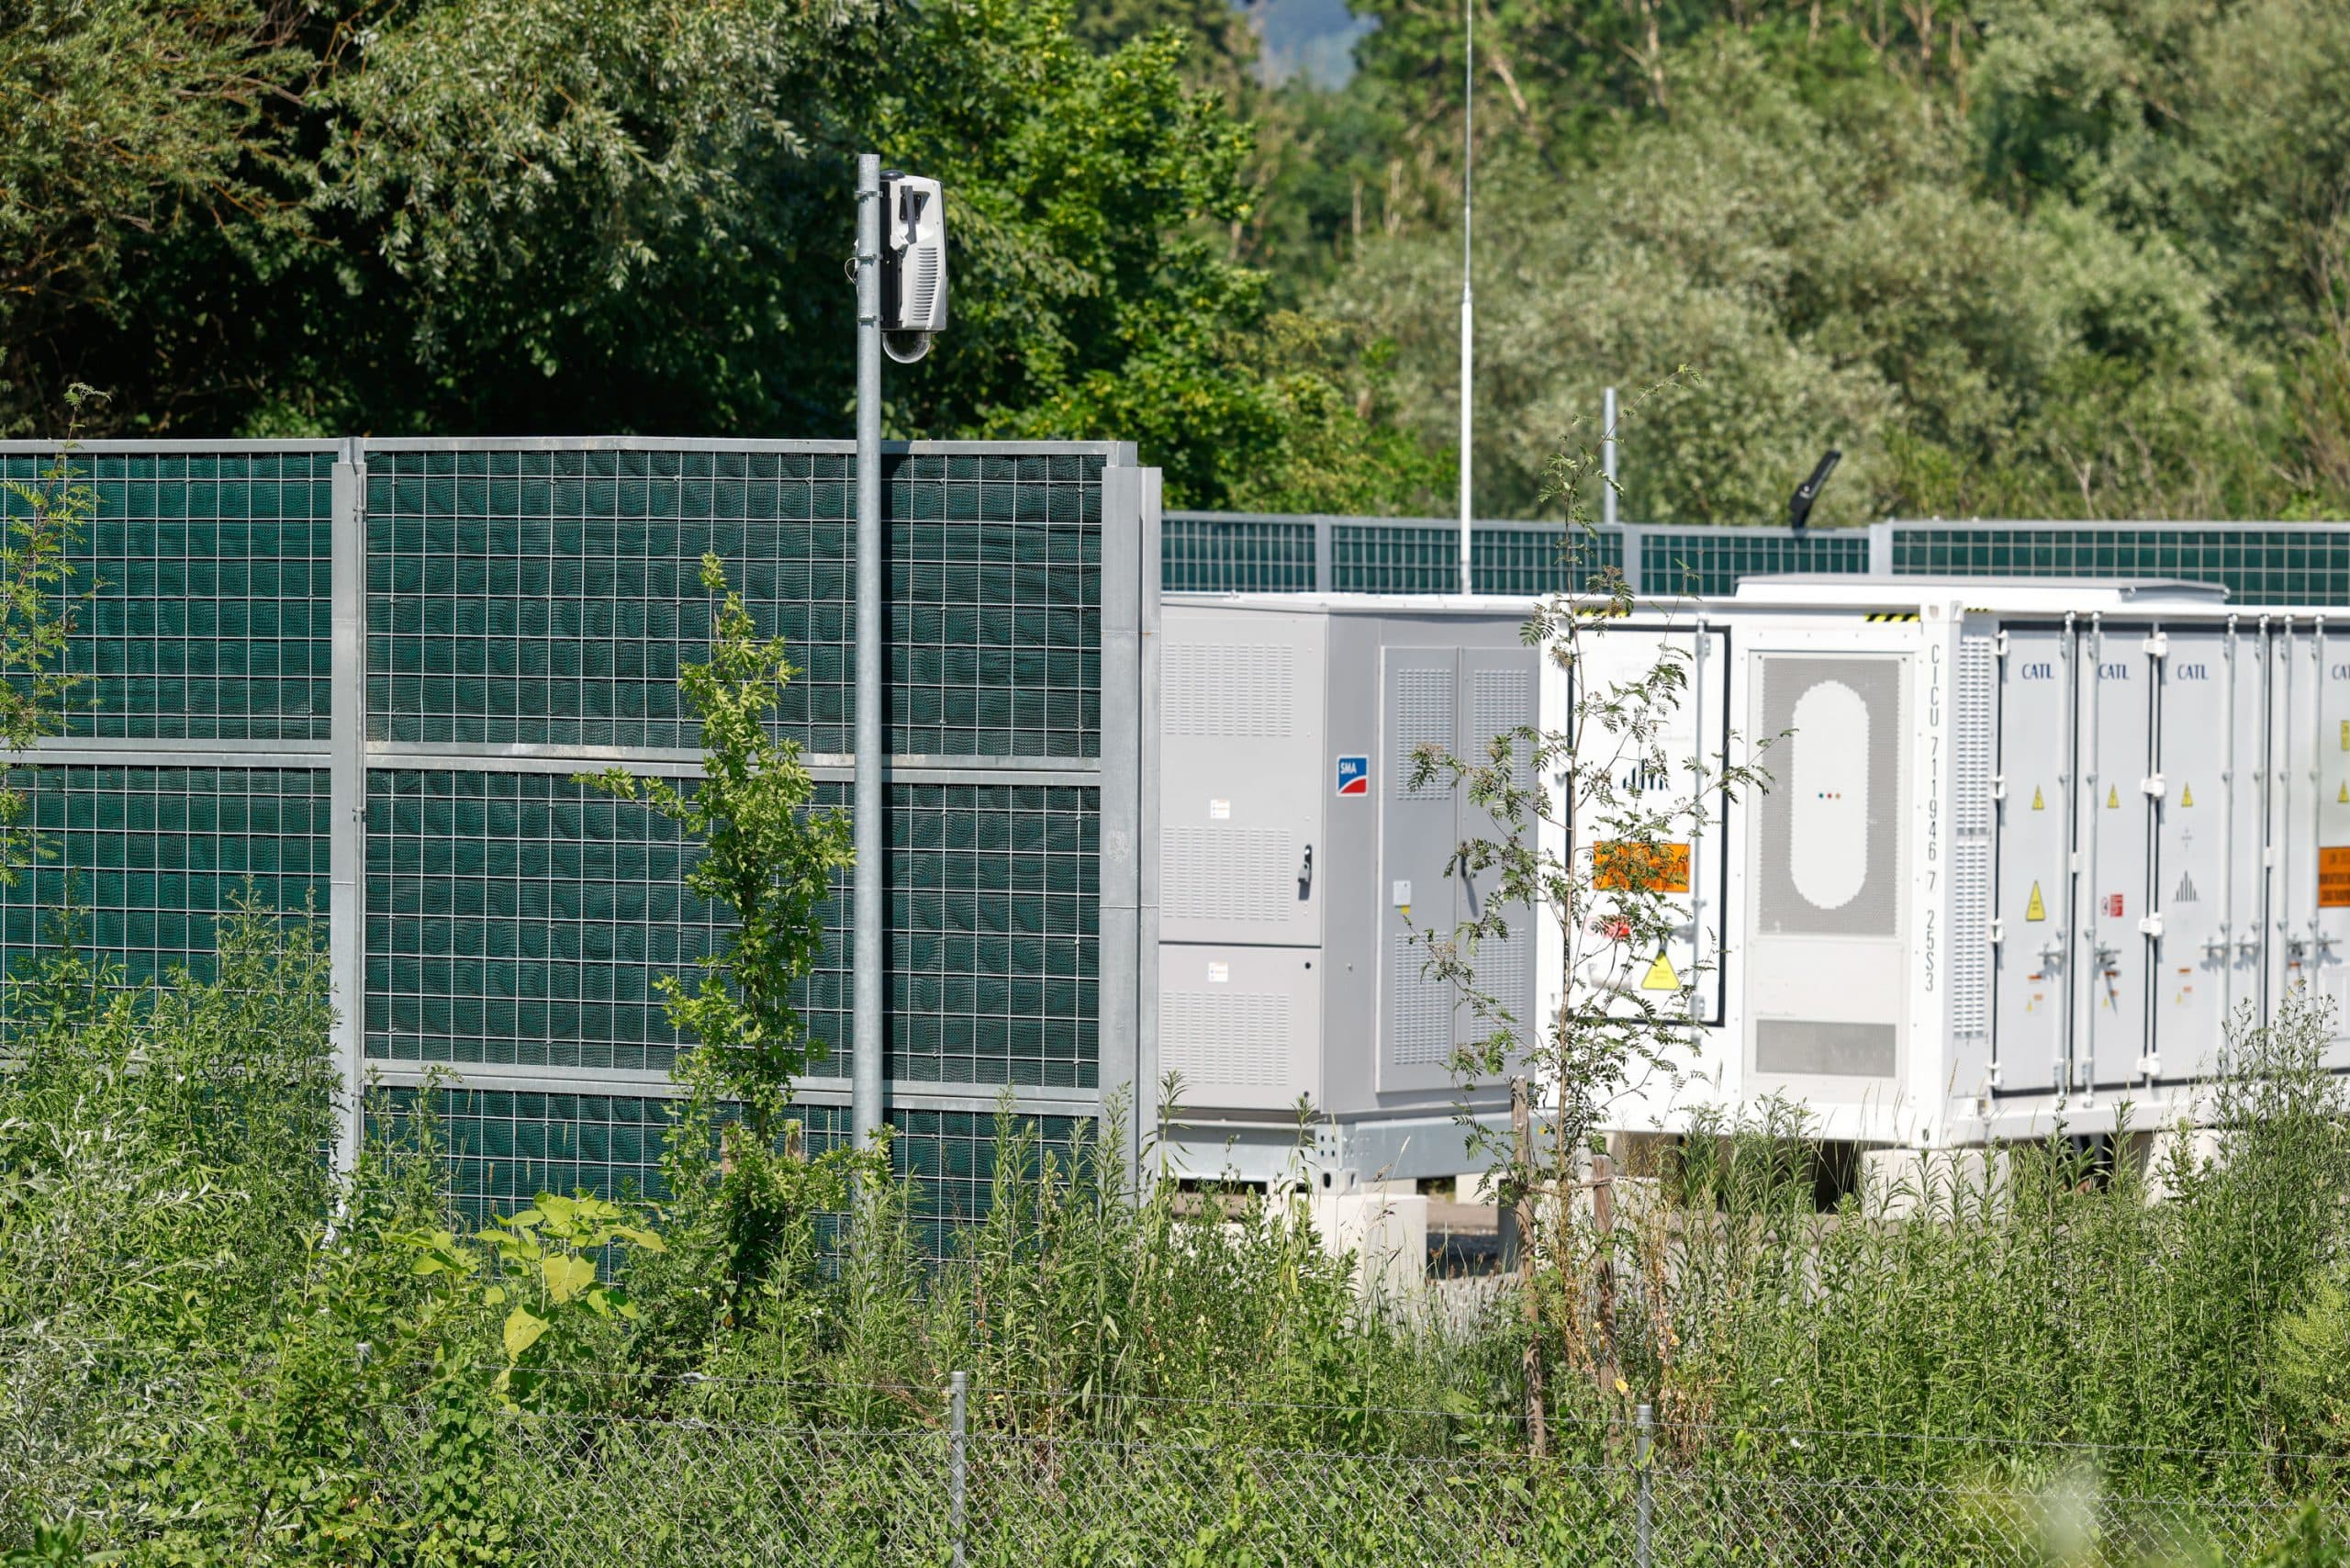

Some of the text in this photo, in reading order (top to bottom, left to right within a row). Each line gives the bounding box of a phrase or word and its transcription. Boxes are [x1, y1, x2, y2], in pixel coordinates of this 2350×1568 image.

[2021, 664, 2054, 679] CATL
[2098, 664, 2130, 679] CATL
[2177, 664, 2209, 679] CATL
[1930, 644, 1940, 727] CICU
[1340, 761, 1357, 774] SMA
[1929, 736, 1939, 861] 711946
[1928, 870, 1936, 890] 7
